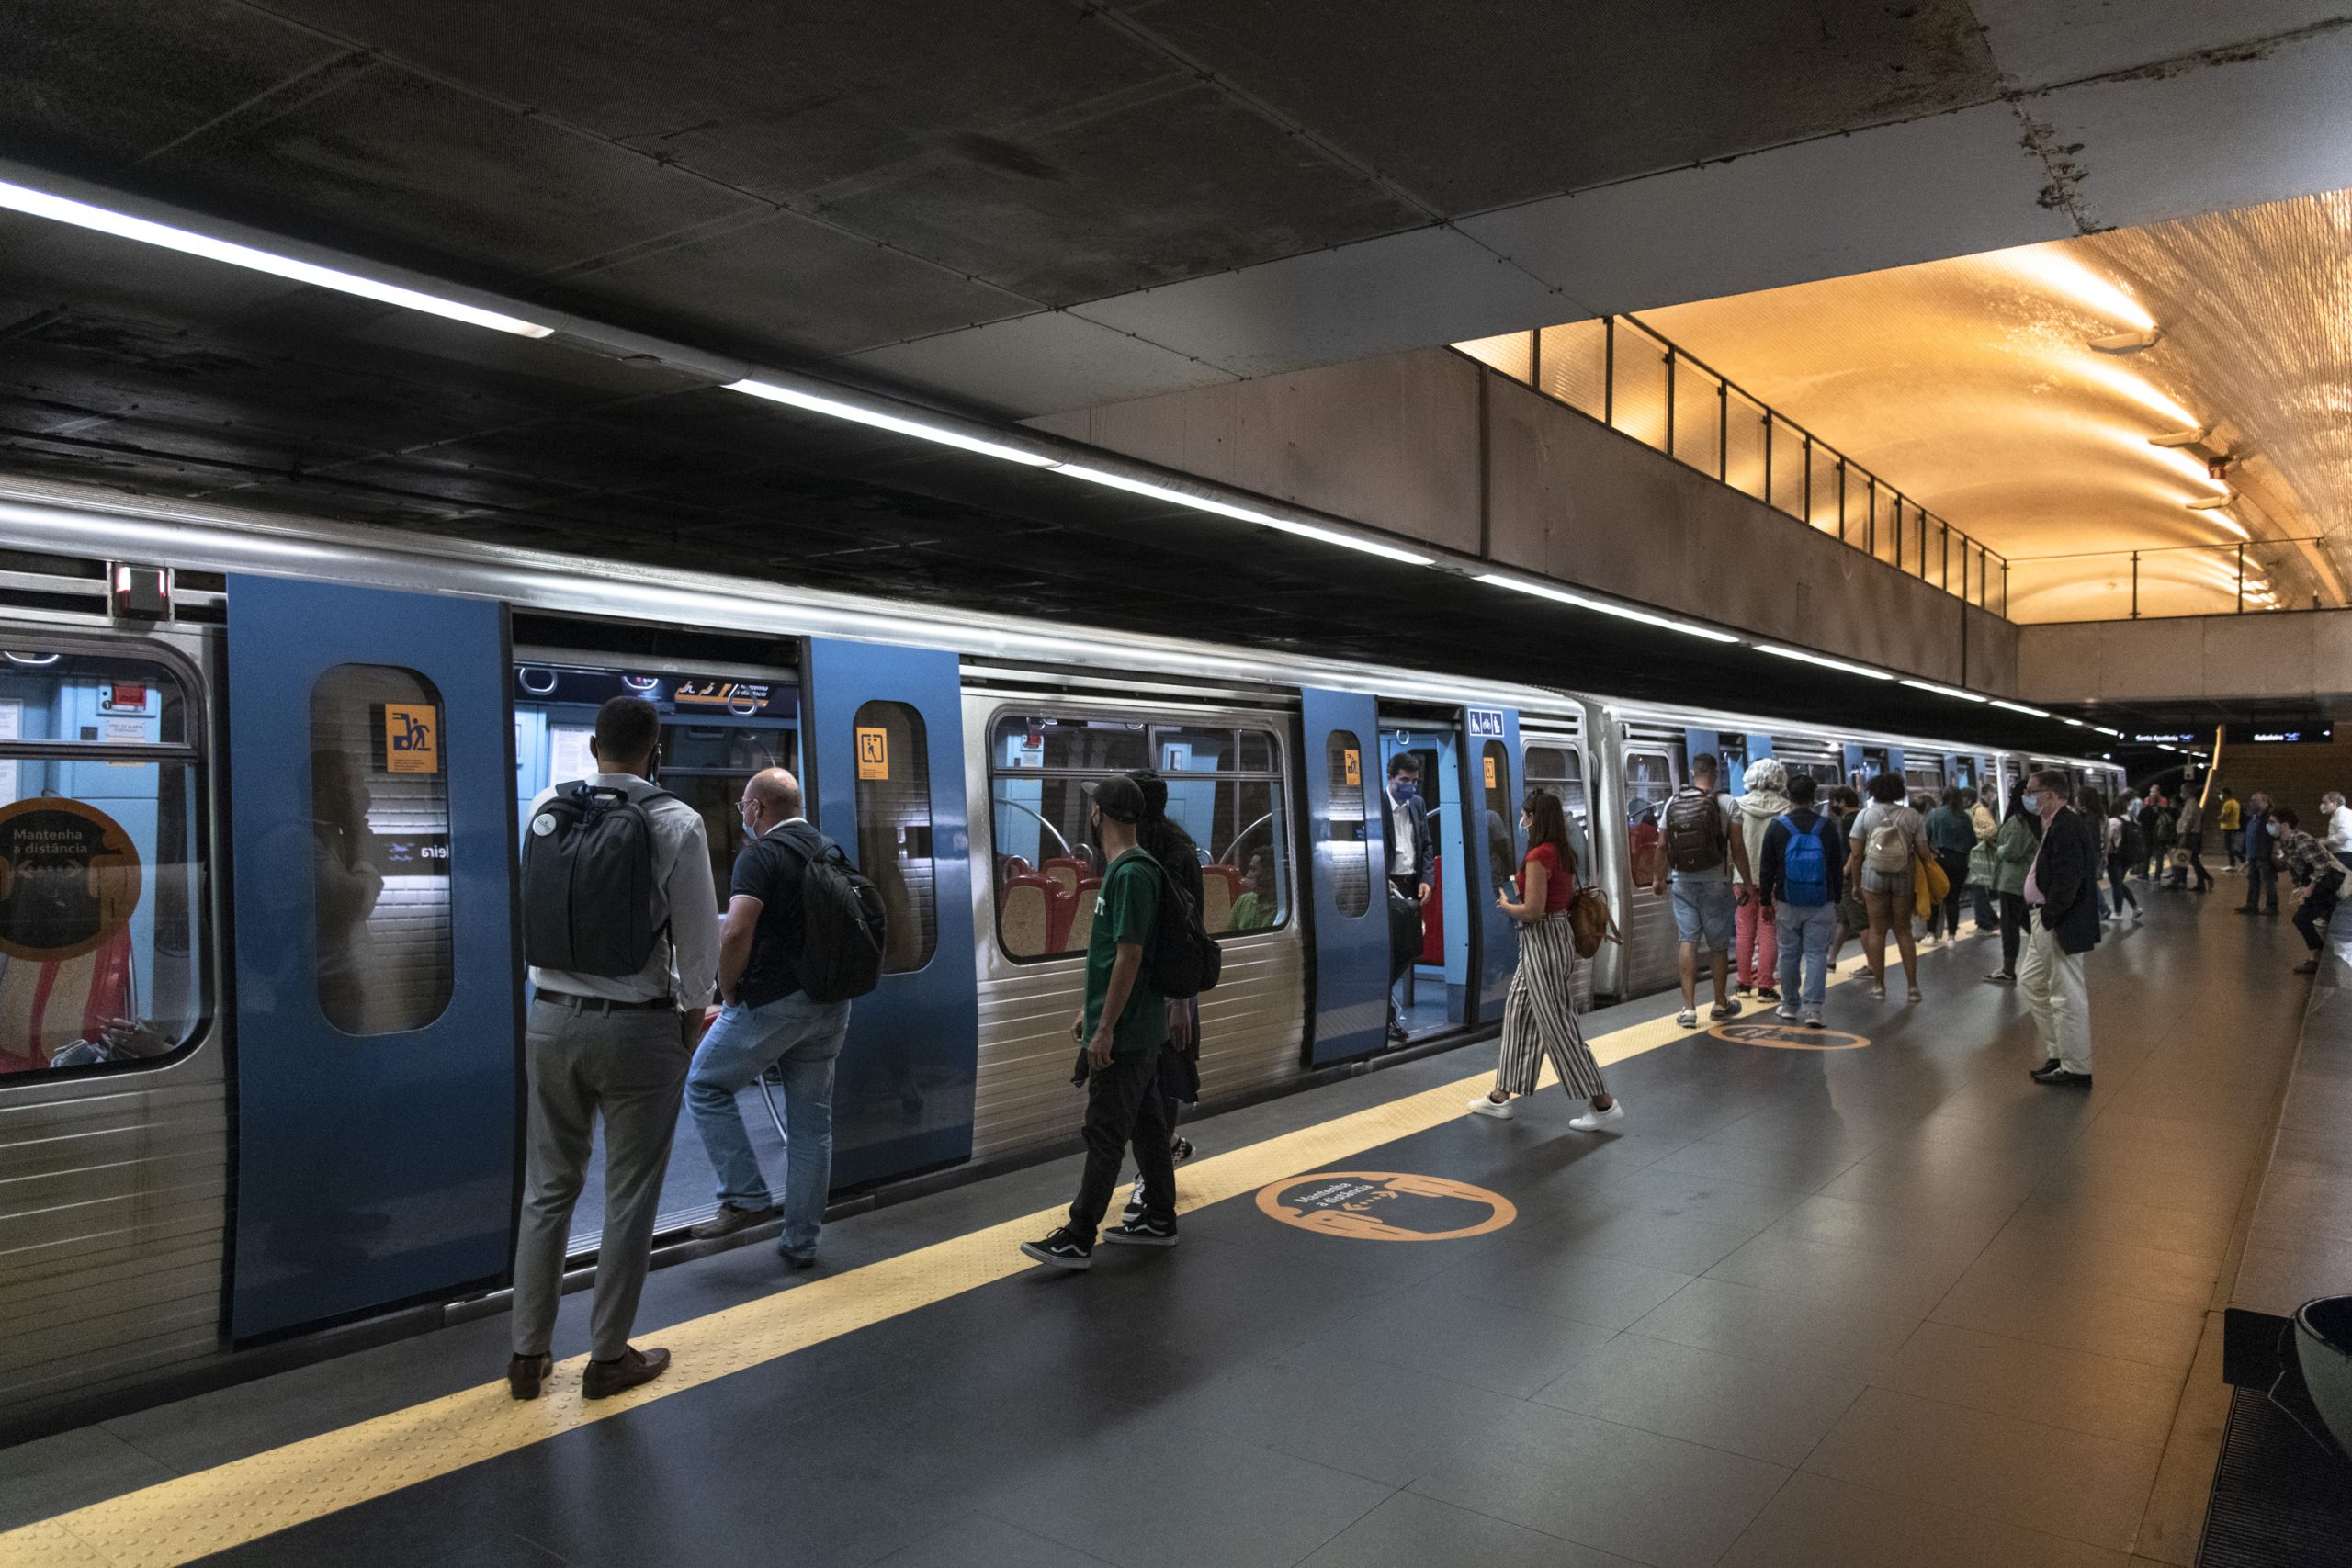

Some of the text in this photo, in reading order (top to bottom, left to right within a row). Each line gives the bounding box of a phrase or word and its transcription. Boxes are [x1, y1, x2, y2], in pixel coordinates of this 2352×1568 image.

[13, 829, 84, 840] Mantenha
[14, 842, 89, 854] a distância
[1294, 1181, 1352, 1204] Mantenha
[1323, 1184, 1374, 1204] distância
